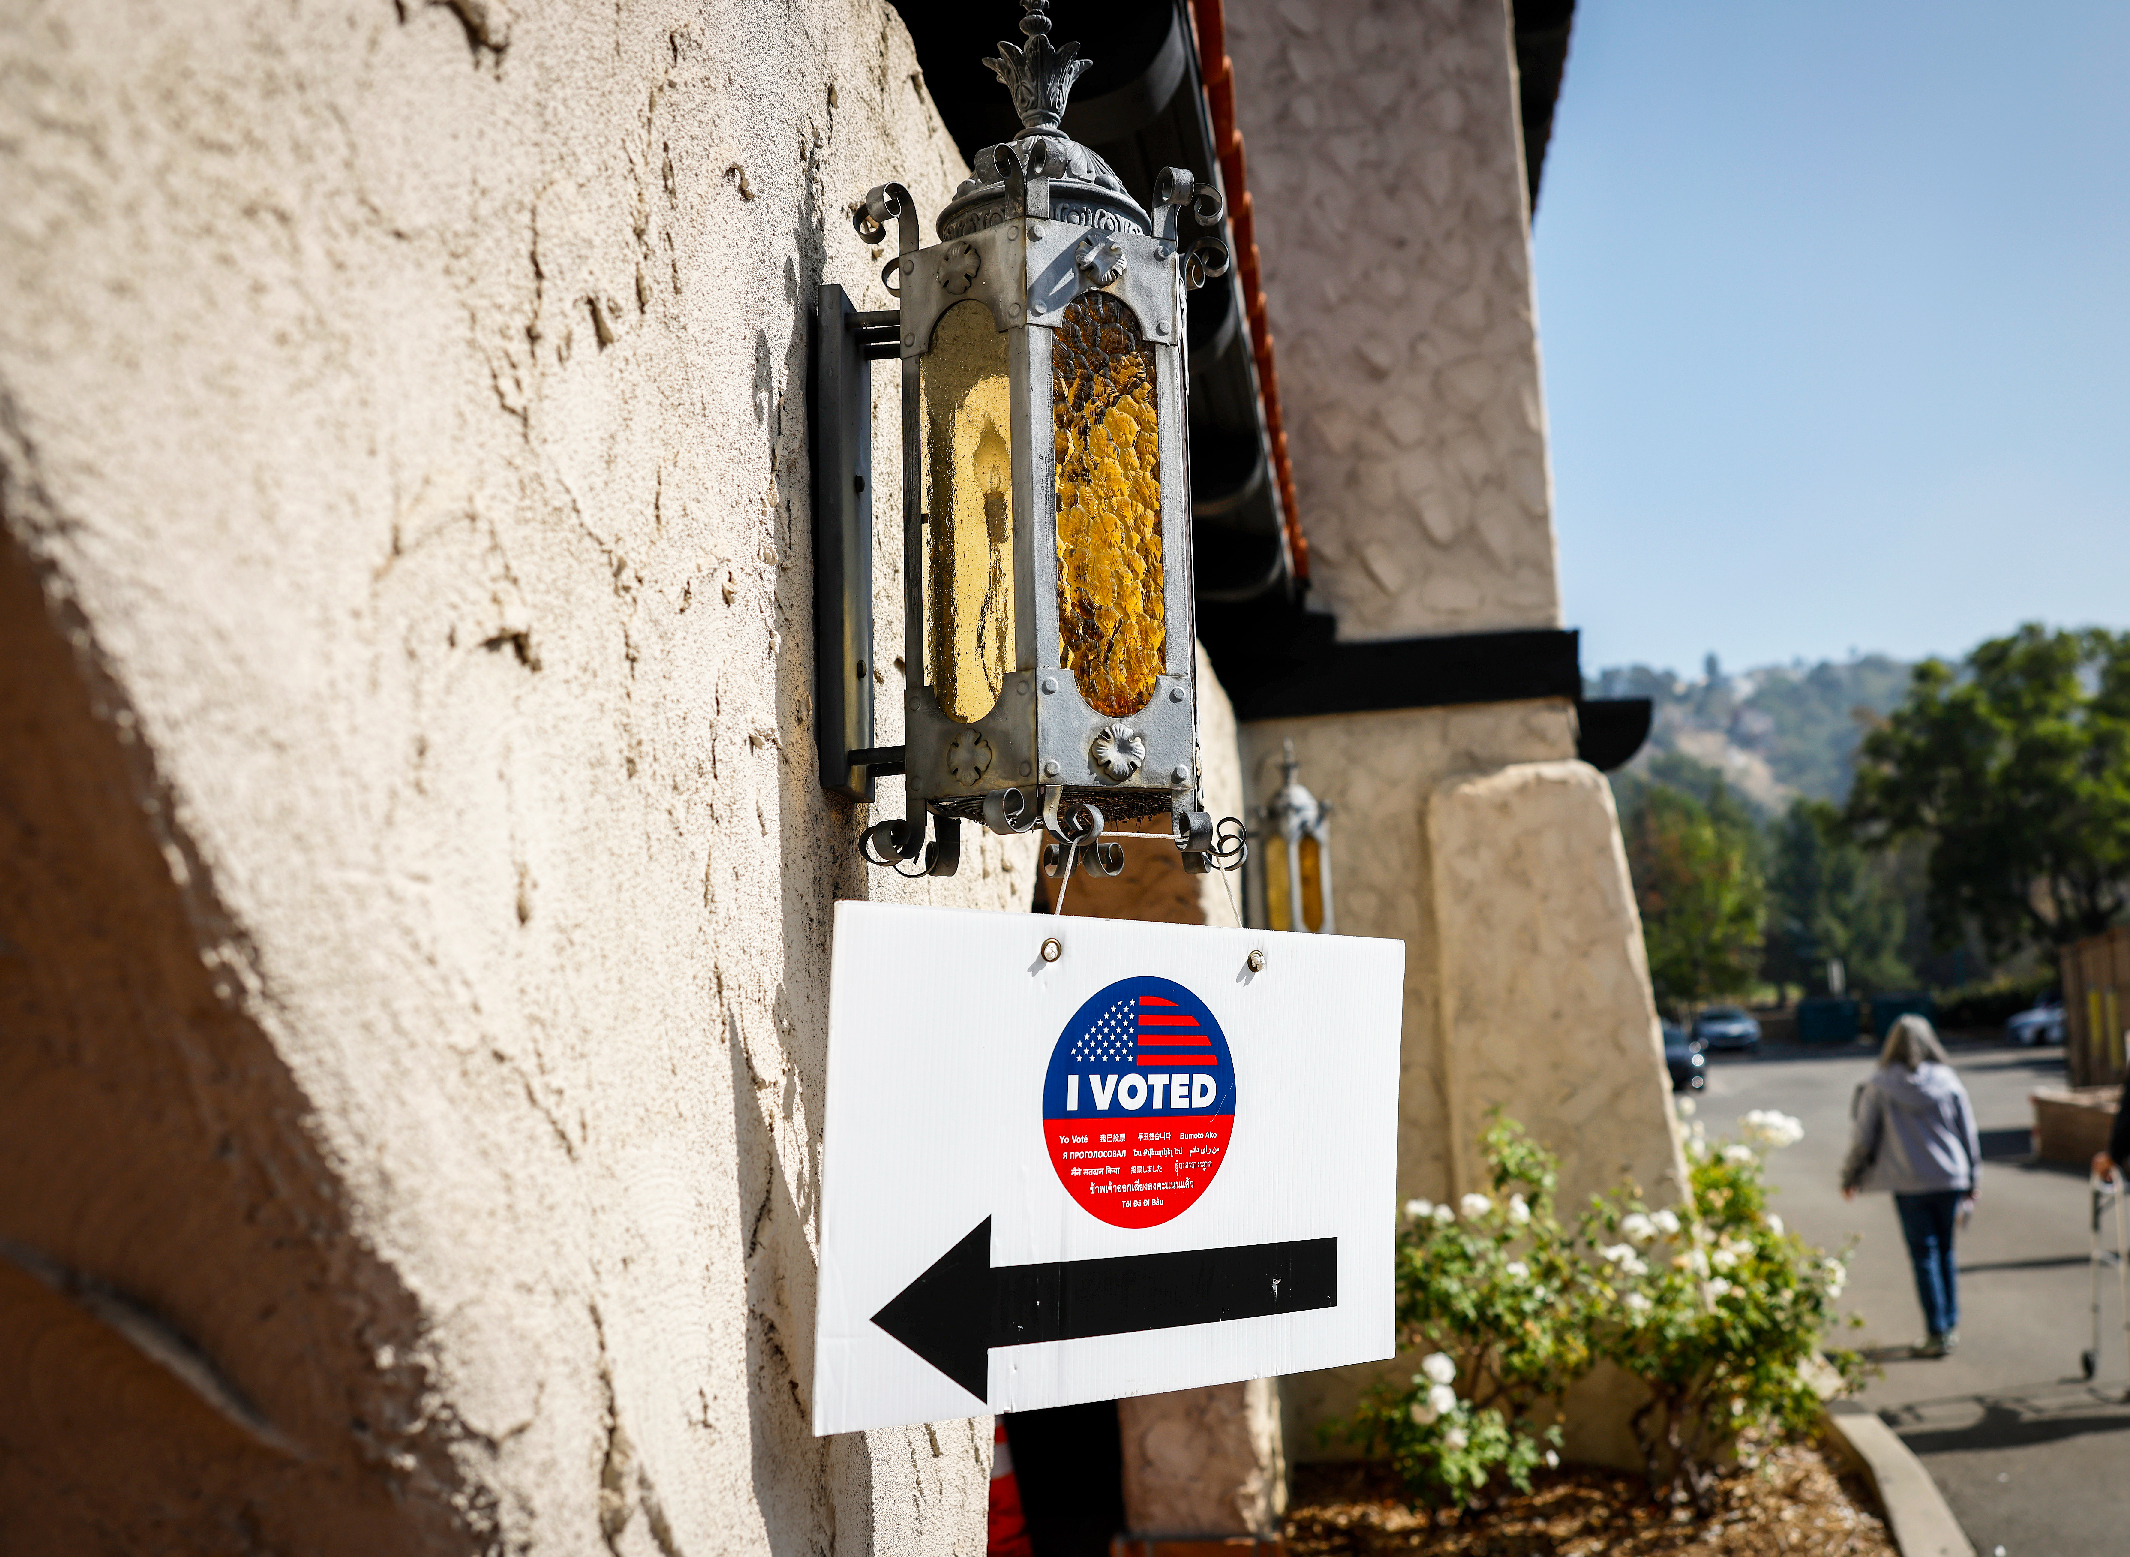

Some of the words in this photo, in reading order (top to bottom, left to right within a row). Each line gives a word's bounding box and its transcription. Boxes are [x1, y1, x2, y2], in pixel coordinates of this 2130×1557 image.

[1066, 1074, 1079, 1111] I
[1088, 1073, 1217, 1111] VOTED
[1059, 1135, 1070, 1144] Yo
[1071, 1134, 1089, 1144] Voté
[1179, 1132, 1204, 1140] Bumoto
[1205, 1131, 1218, 1139] Ako
[1062, 1151, 1068, 1160] Я
[1069, 1149, 1127, 1160] ПРОГОЛОСОВАЛ
